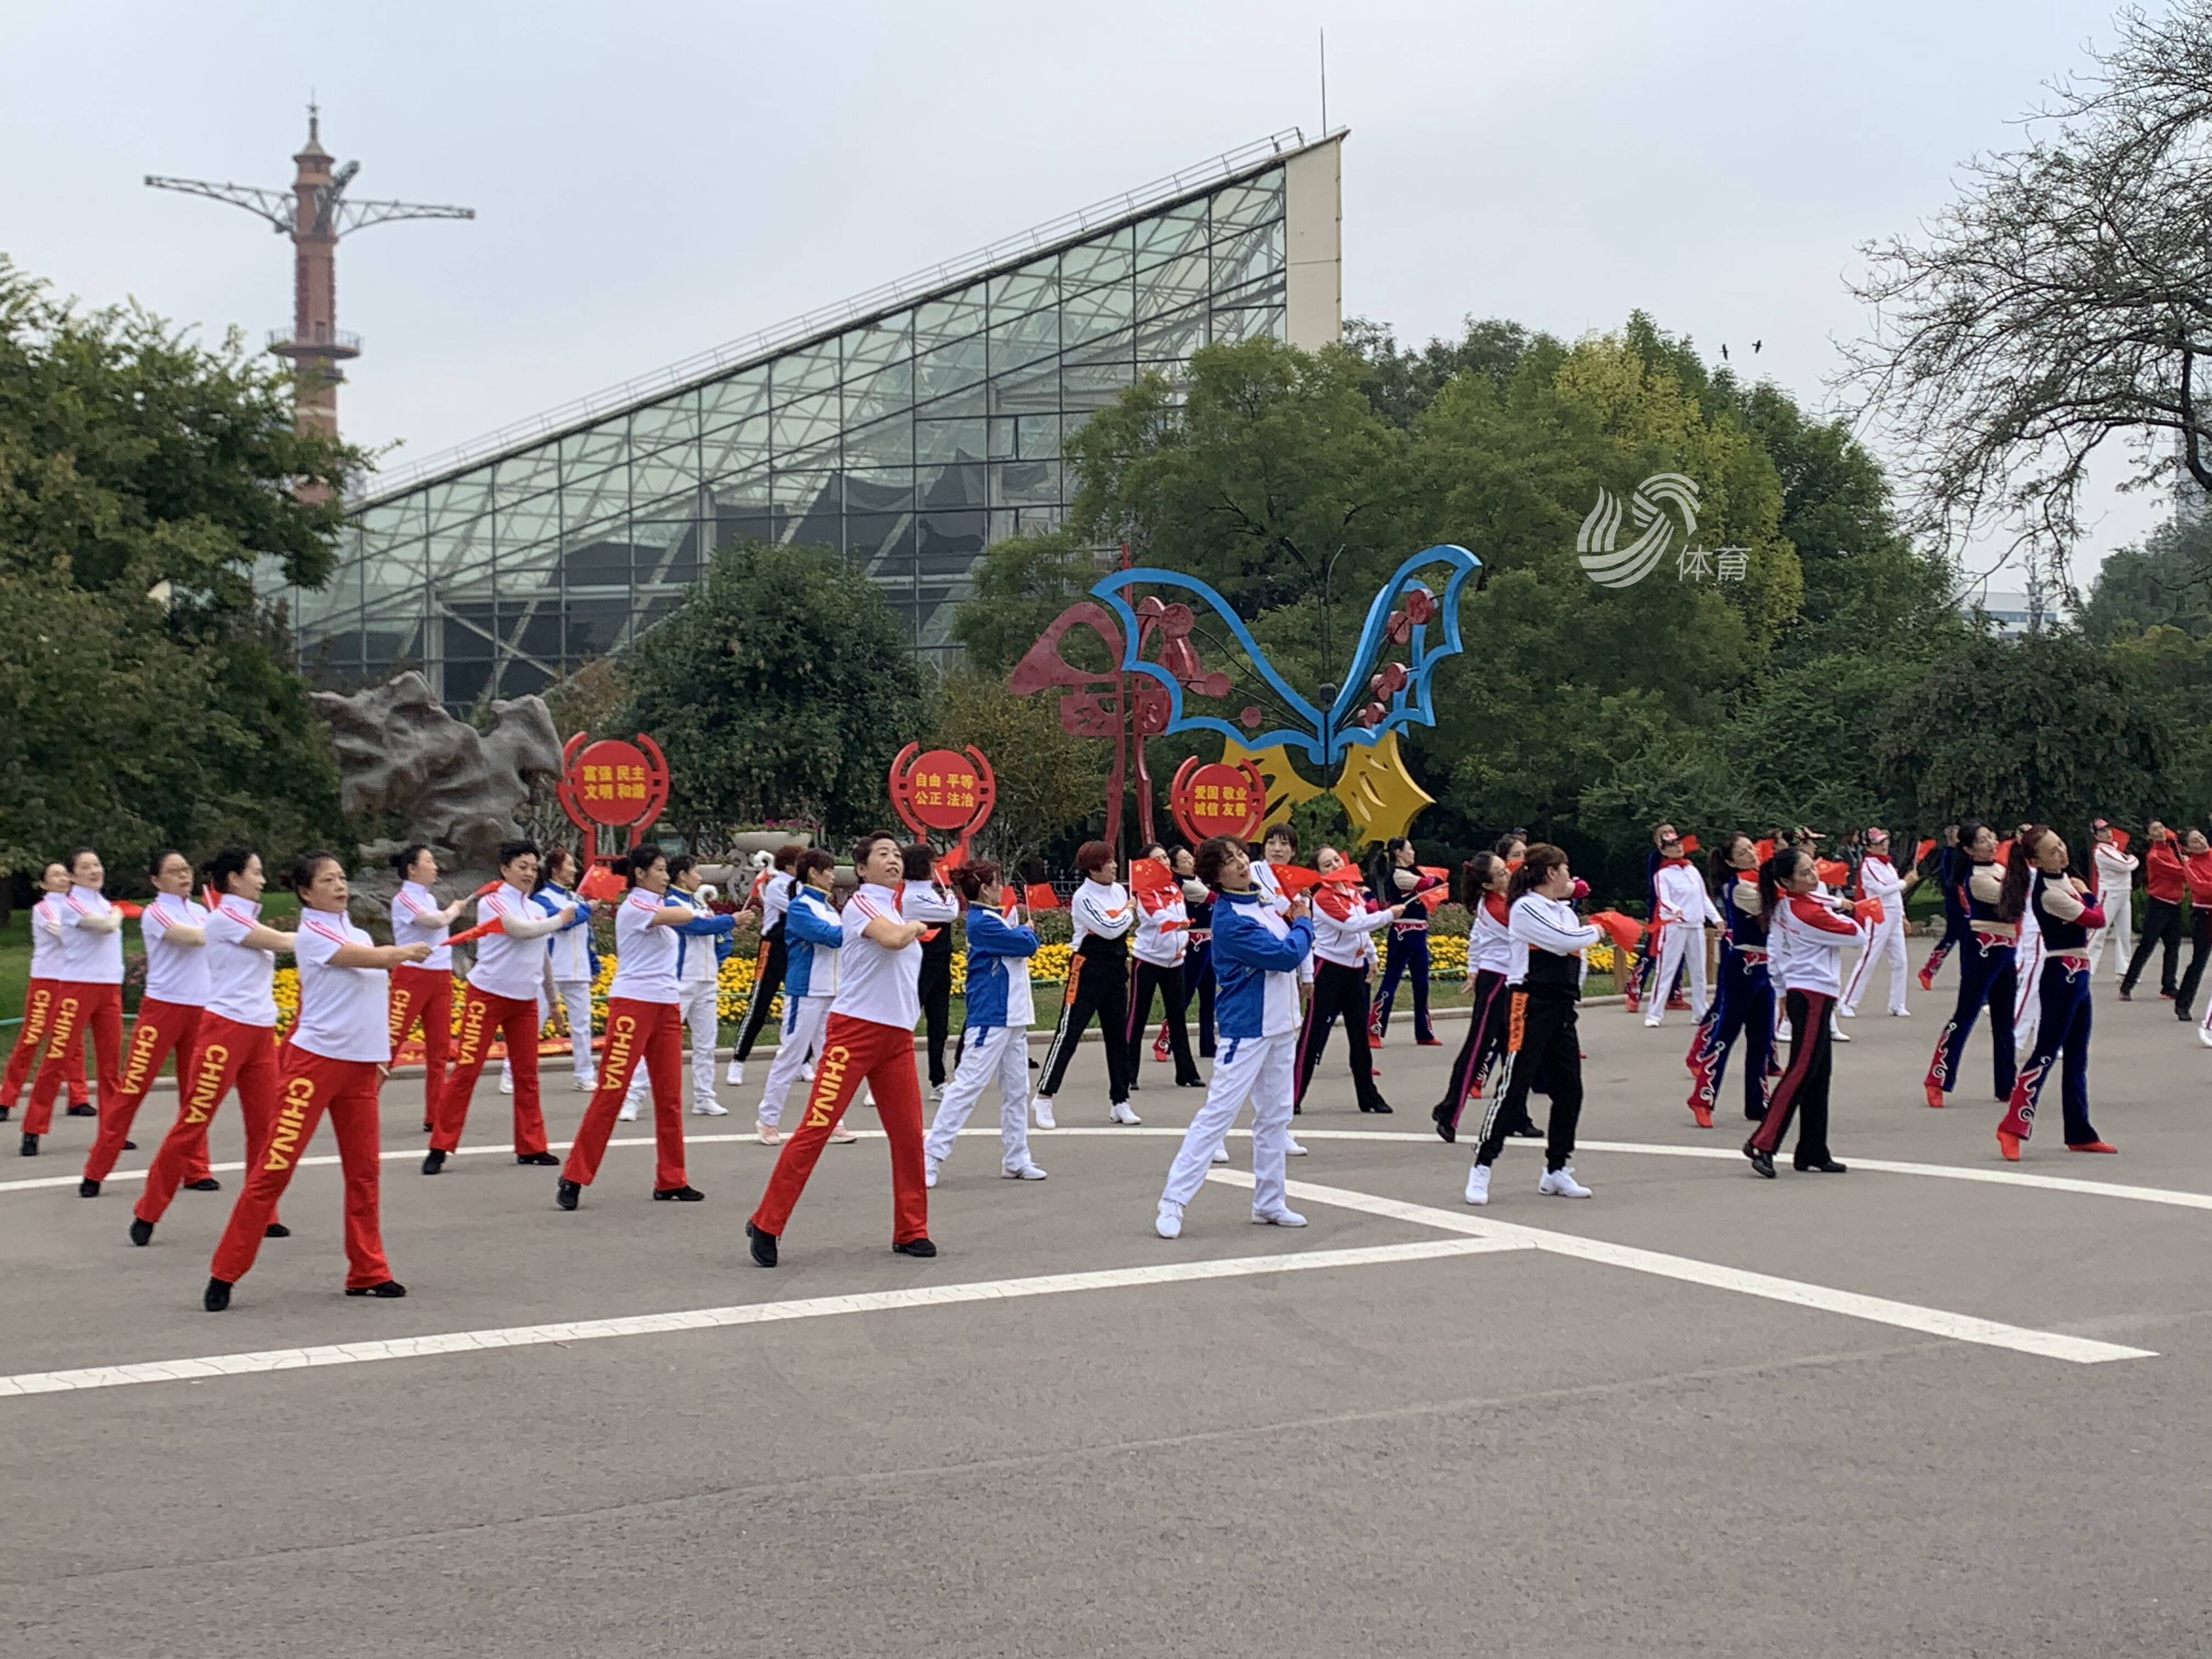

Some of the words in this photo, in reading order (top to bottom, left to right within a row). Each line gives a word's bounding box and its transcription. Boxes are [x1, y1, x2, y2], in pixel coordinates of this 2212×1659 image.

[584, 783, 614, 800] 文明
[617, 765, 646, 781] 民主
[915, 772, 941, 787] 自由
[946, 774, 974, 789] 平等
[915, 791, 942, 805] 公正
[946, 792, 974, 807] 法治
[1194, 785, 1219, 799] 爱国
[1222, 786, 1248, 800] 敬业
[1194, 802, 1219, 816] 诚信
[1222, 802, 1247, 817] 友善
[23, 989, 51, 1045] CHINA
[47, 998, 79, 1059] CHINA
[458, 1000, 486, 1064] CHINA
[121, 1025, 158, 1094] CHINA
[602, 1015, 636, 1090] CHINA
[184, 1045, 229, 1123] CHINA
[806, 1046, 850, 1126] CHINA
[263, 1077, 314, 1171] CHINA
